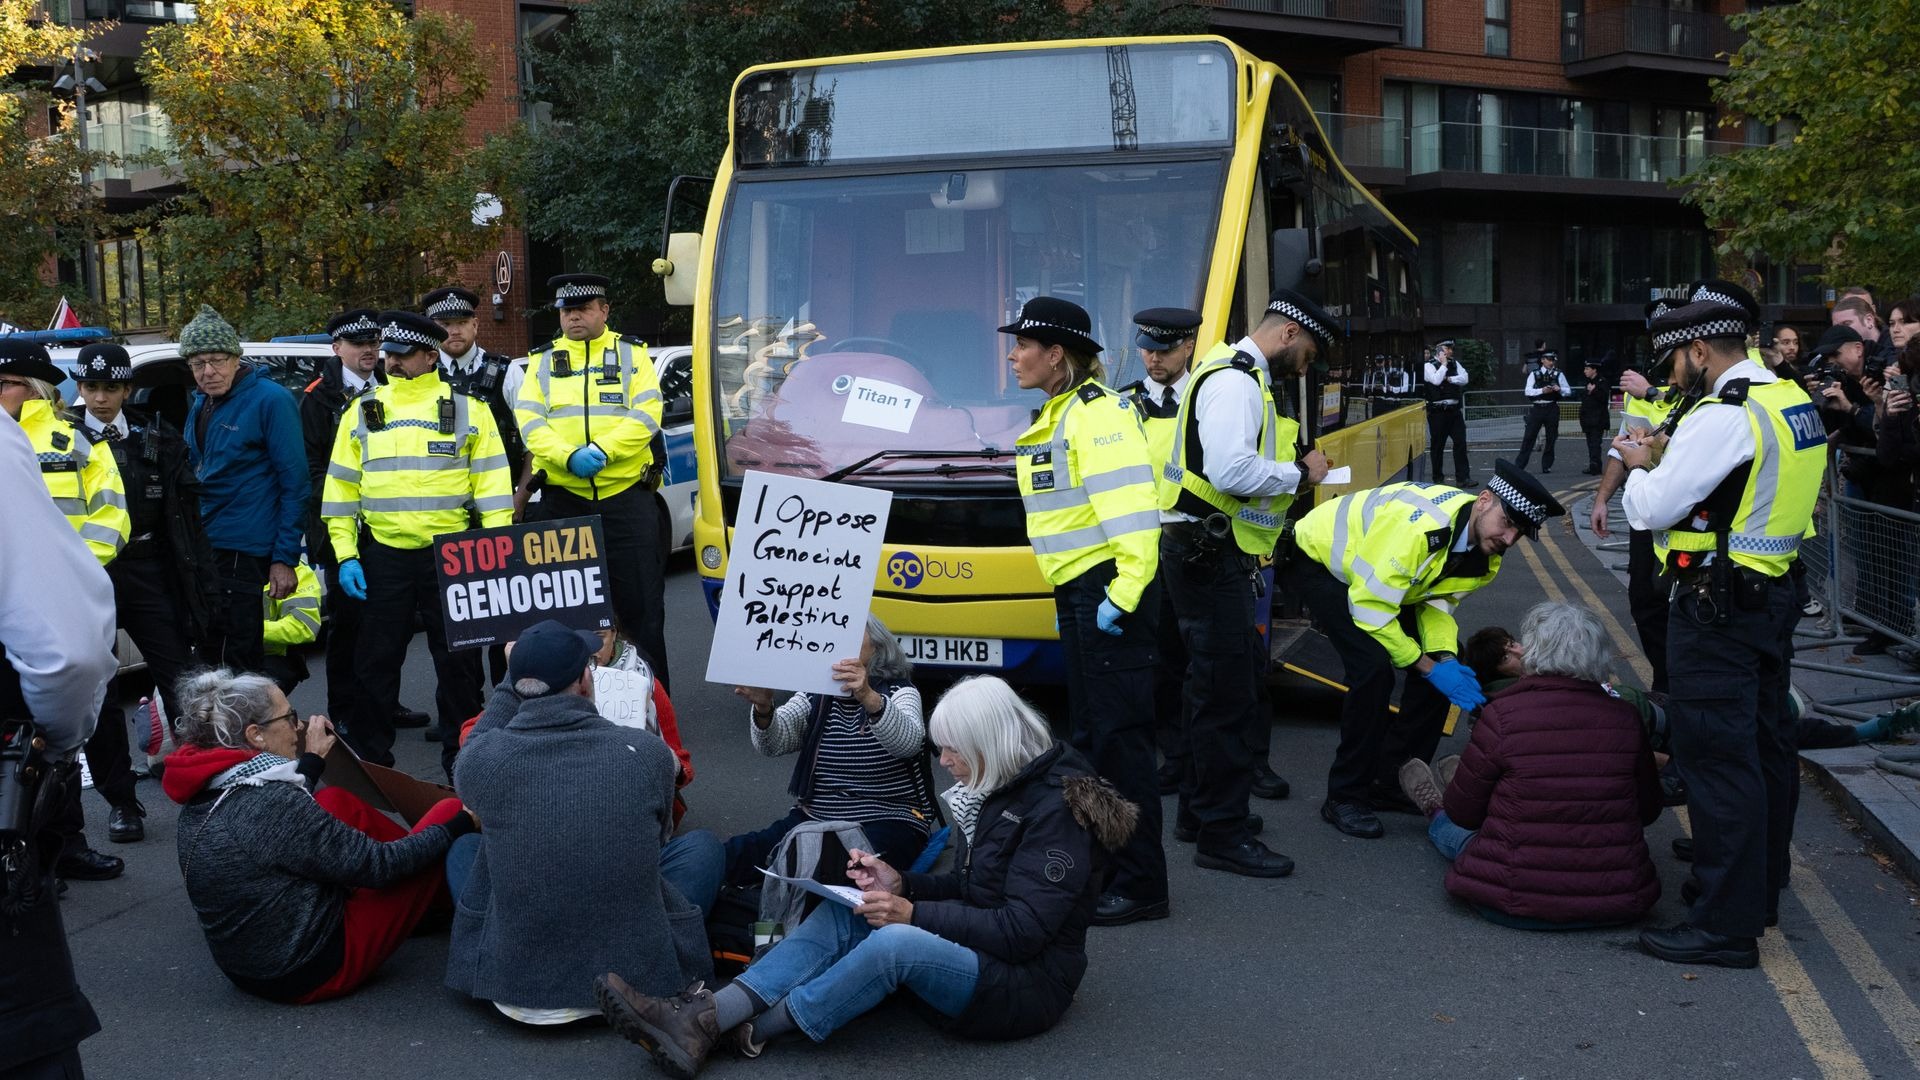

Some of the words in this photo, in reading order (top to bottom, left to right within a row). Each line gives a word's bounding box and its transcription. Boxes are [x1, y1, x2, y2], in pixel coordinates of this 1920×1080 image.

[857, 386, 898, 407] Titan
[903, 397, 912, 409] 1
[1093, 431, 1124, 447] POLICE
[754, 484, 769, 524] I
[776, 494, 877, 538] Oppose
[441, 535, 513, 576] STOP
[522, 525, 598, 566] GAZA
[753, 528, 862, 570] Genocide
[446, 566, 605, 622] GENOCIDE
[738, 572, 746, 599] I
[744, 600, 850, 629] Palestine
[756, 628, 835, 653] Action
[944, 639, 989, 662] HKB
[598, 699, 641, 720] CIDE
